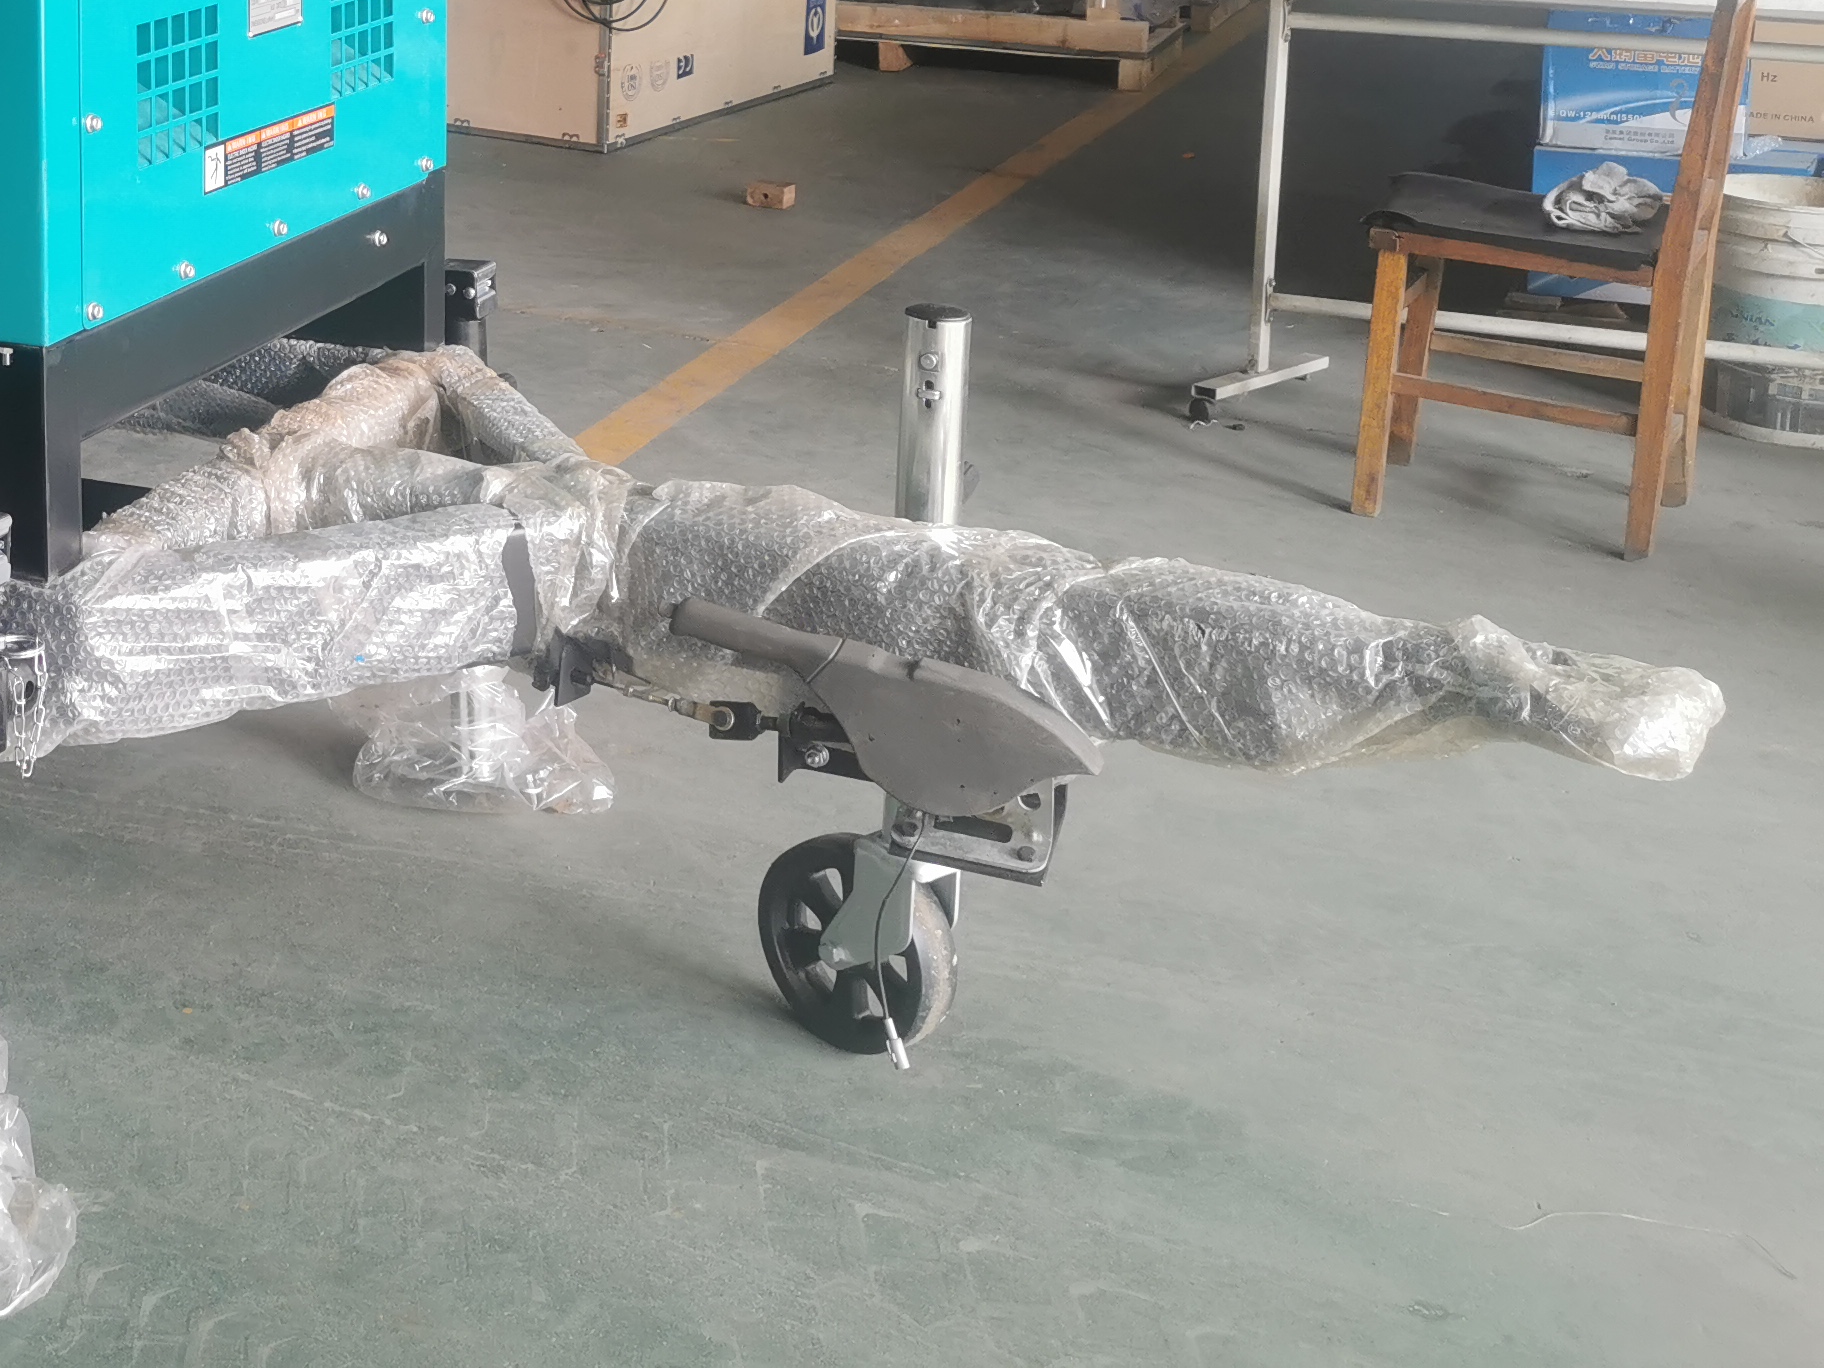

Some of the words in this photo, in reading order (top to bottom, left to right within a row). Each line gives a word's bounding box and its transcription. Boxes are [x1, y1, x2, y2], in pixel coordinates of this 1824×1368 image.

[1760, 72, 1778, 83] Hz
[1749, 111, 1769, 120] ADE
[1771, 113, 1781, 121] IN
[1783, 114, 1815, 124] CHINA
